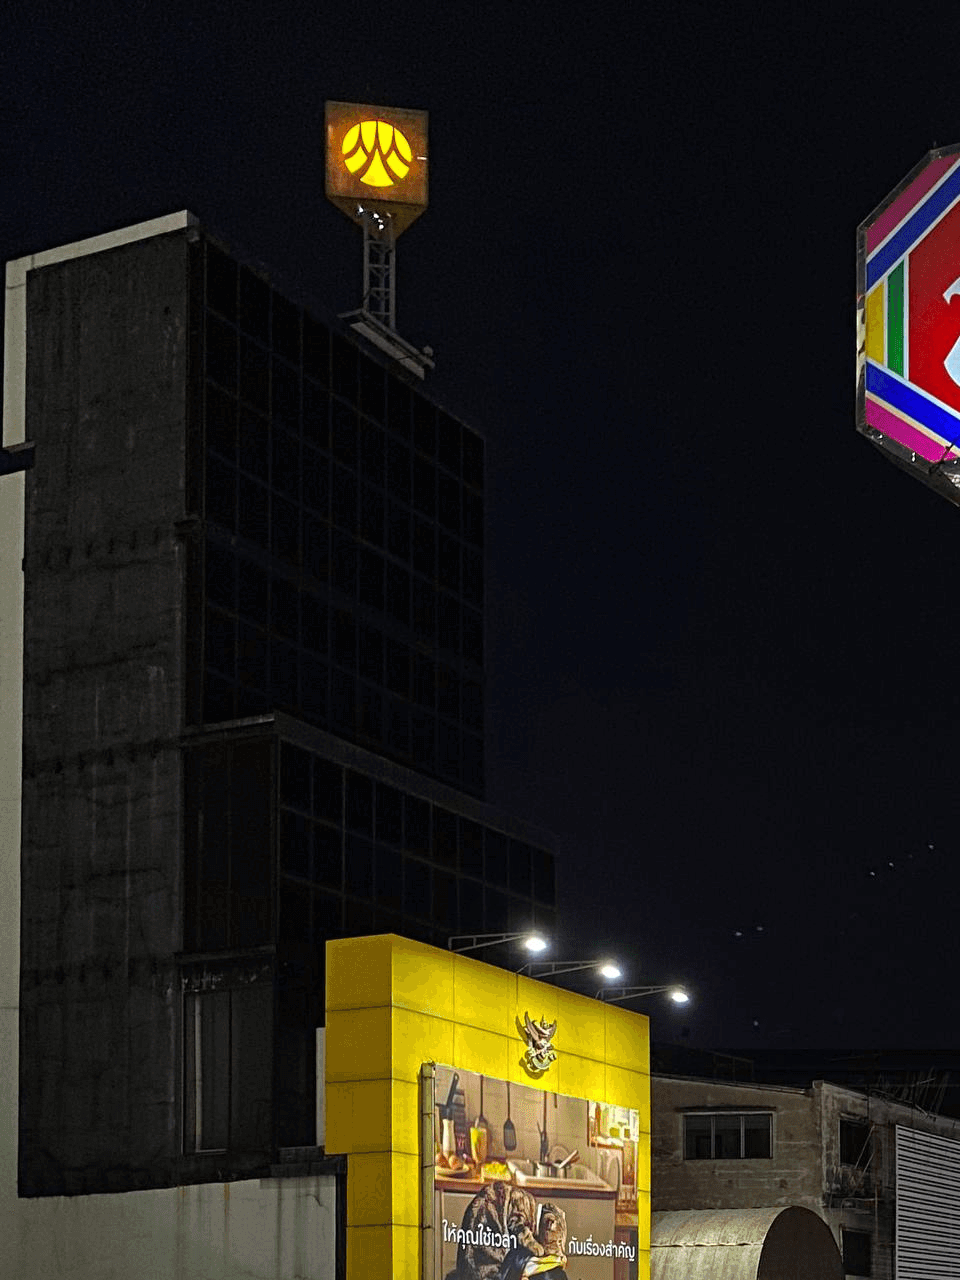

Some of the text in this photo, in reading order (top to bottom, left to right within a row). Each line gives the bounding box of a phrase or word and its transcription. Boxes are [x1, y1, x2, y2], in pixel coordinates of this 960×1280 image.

[442, 1219, 636, 1262] ให้คุณใช้เวลา กับเรื่องสำคัญ
